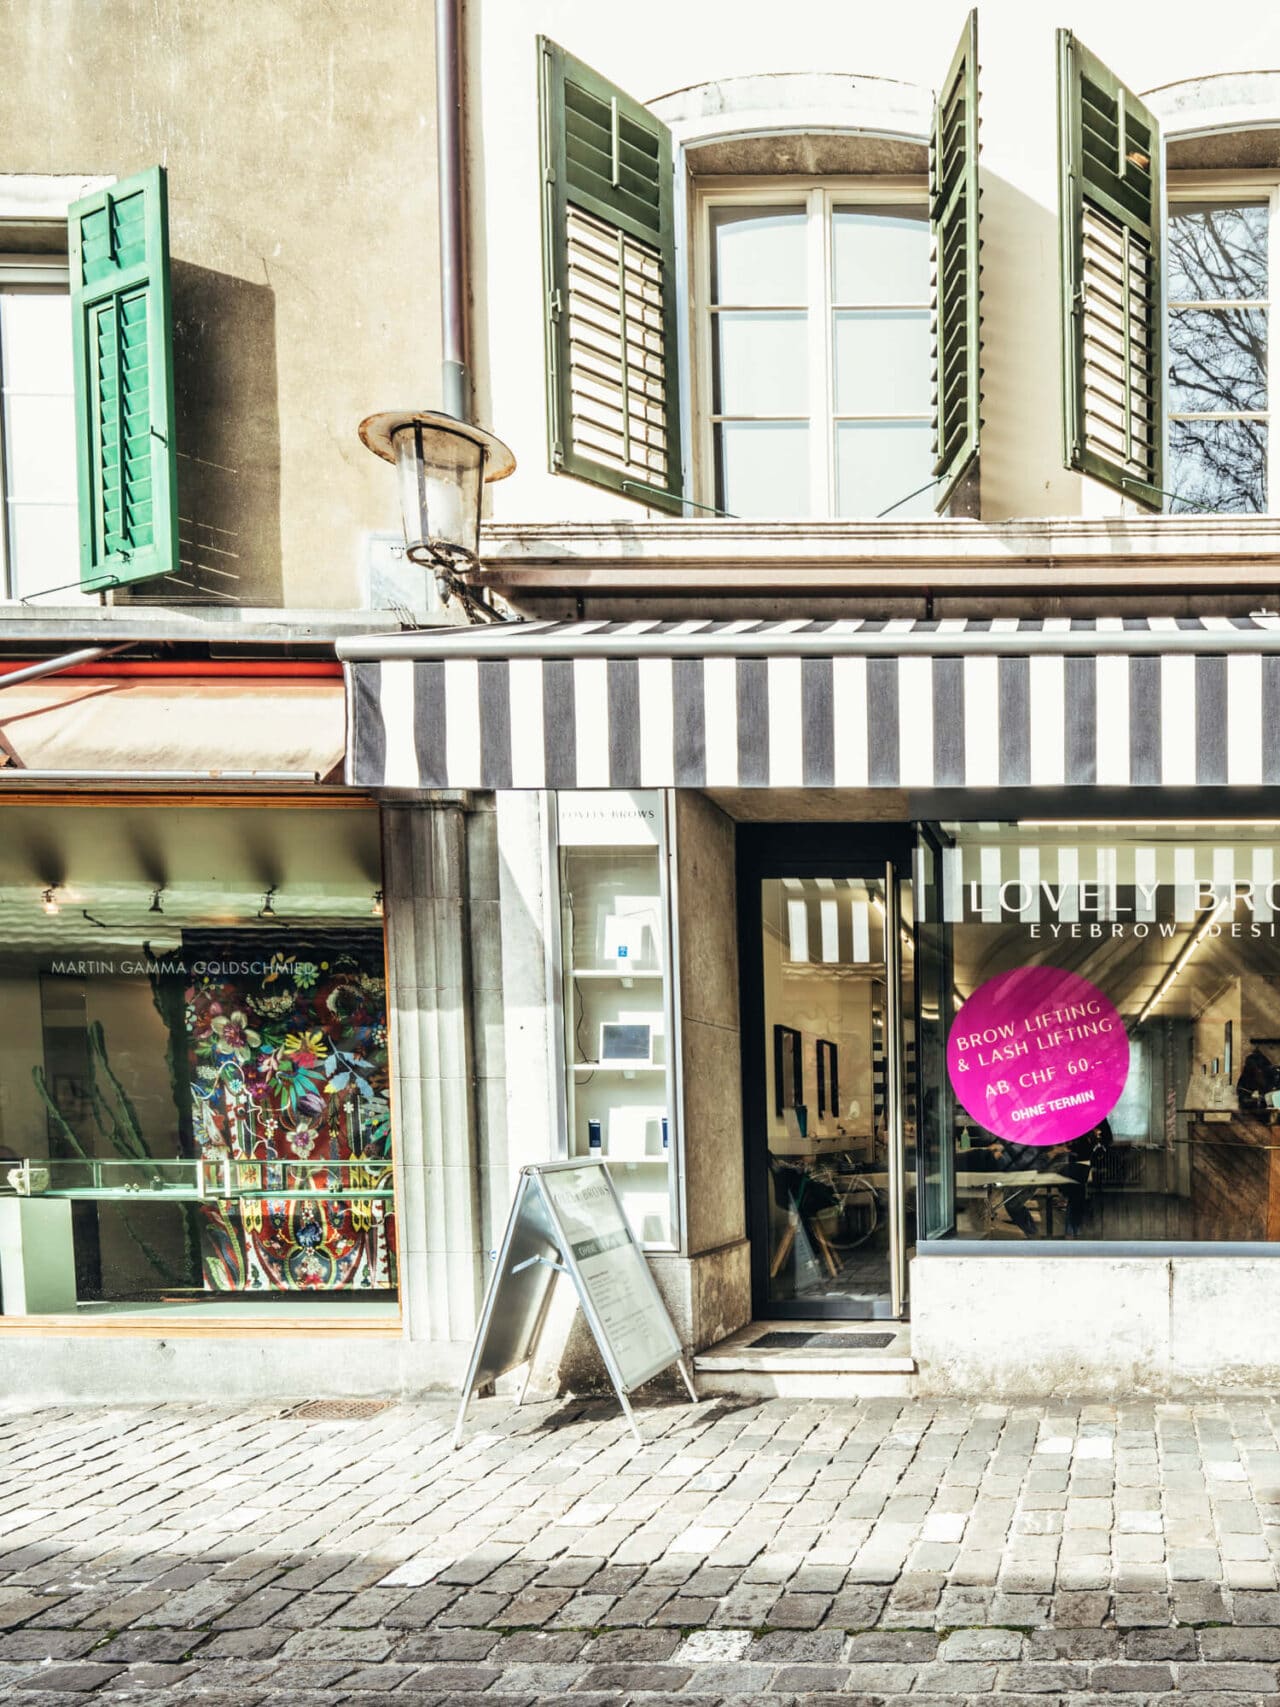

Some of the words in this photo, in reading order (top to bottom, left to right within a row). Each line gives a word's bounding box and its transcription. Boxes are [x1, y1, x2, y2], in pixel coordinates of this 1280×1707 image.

[970, 879, 1161, 913] LOVELY
[1030, 923, 1178, 938] EYEBROW
[51, 960, 114, 974] MARTIN
[120, 960, 187, 974] GAMMA
[193, 960, 314, 975] GOLDSCHMIED
[956, 1021, 1015, 1051] BROW
[1024, 1000, 1101, 1033] LIFTING
[957, 1058, 970, 1072] &
[978, 1041, 1029, 1067] LASH
[1036, 1017, 1113, 1050] LIFTING
[985, 1080, 1010, 1098] AB
[1019, 1066, 1057, 1088] CHF
[1067, 1057, 1103, 1075] 60.-
[1011, 1103, 1047, 1122] OHNE
[1049, 1090, 1096, 1112] TERMIN
